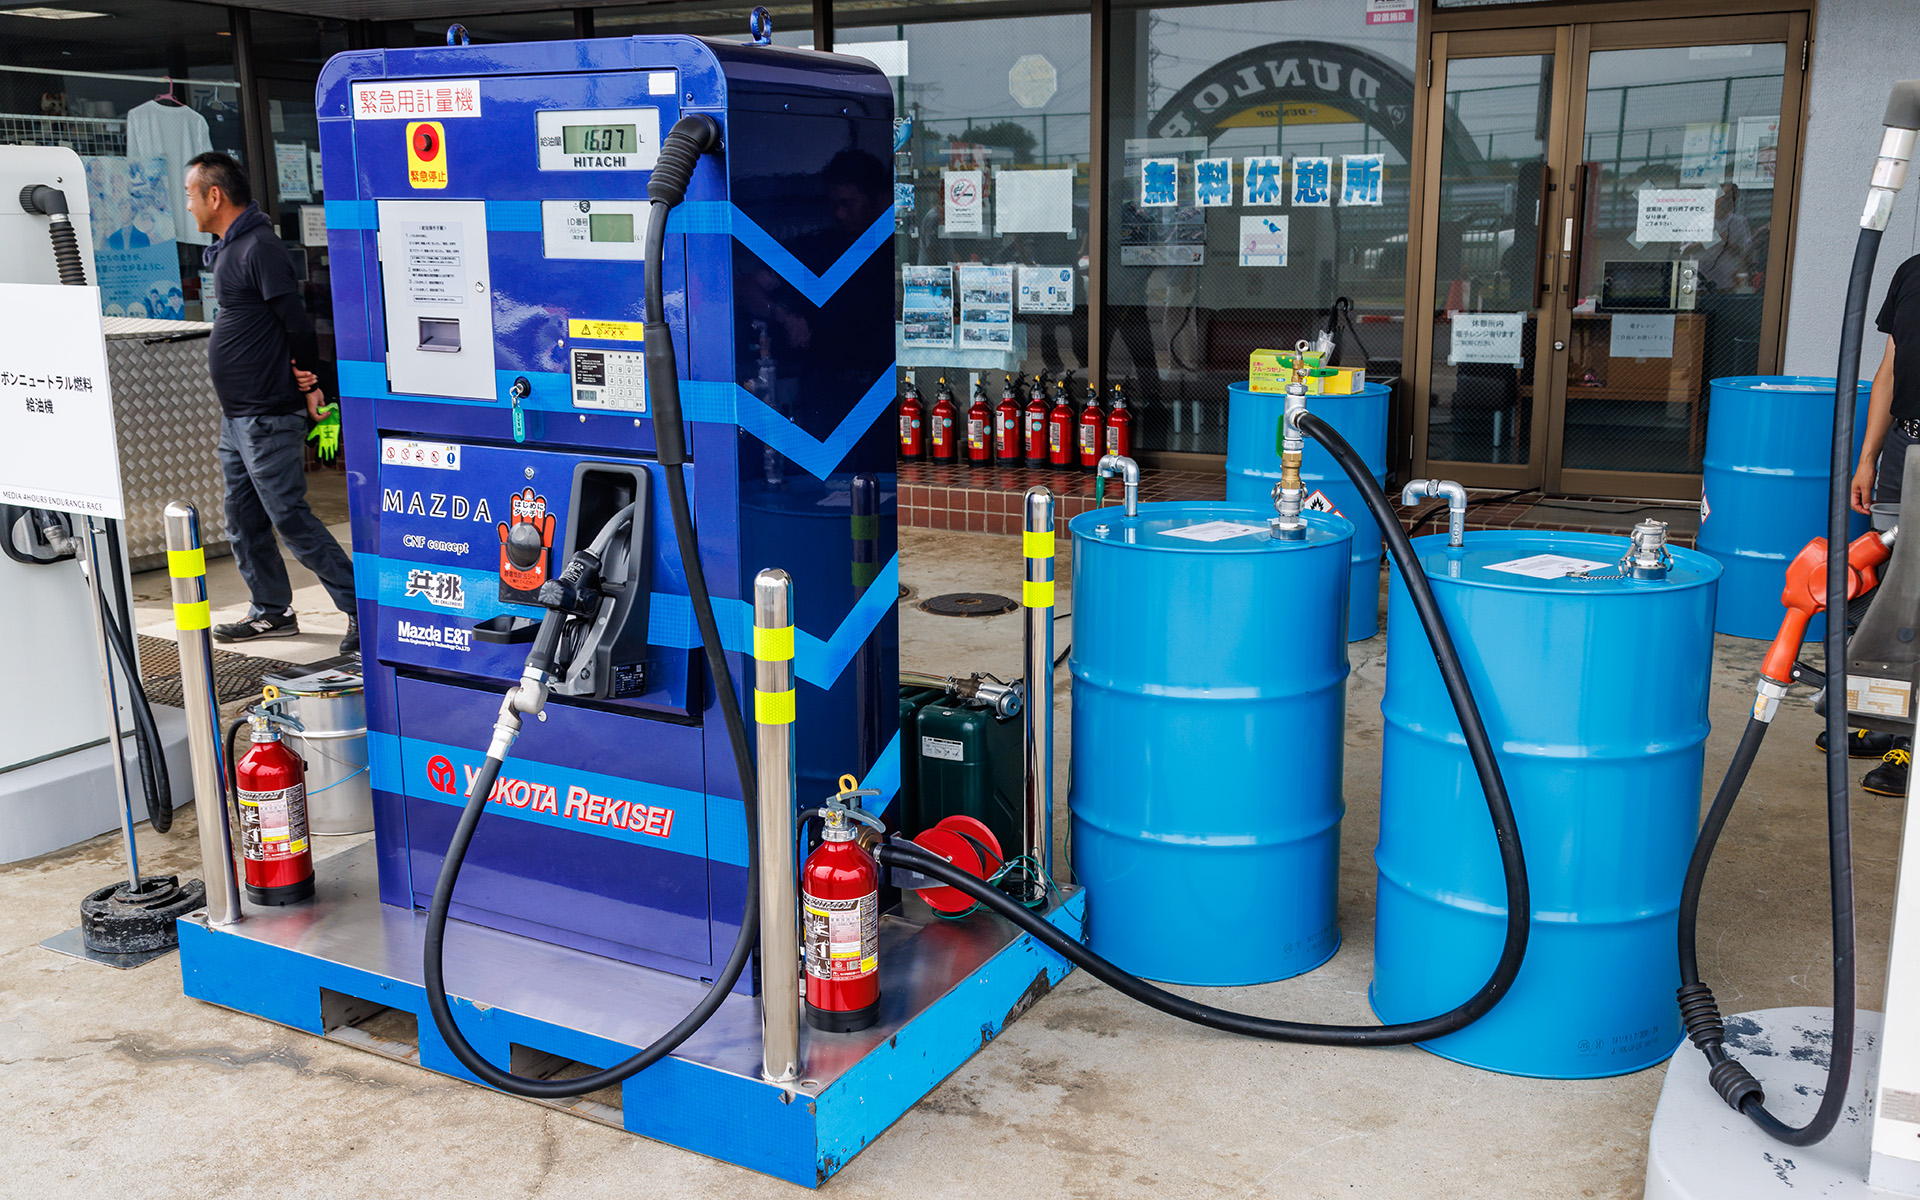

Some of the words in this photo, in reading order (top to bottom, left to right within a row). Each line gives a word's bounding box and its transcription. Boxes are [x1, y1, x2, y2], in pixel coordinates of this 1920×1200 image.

[359, 88, 474, 115] 緊急用計量機
[540, 136, 562, 147] 給油量
[573, 156, 627, 168] HITACHI
[410, 170, 447, 184] 緊急停止
[1143, 157, 1381, 205] 無料休憩所
[567, 217, 589, 227] ID番号
[1472, 320, 1505, 328] 休憩所内
[26, 397, 55, 415] 給油機
[3, 491, 22, 500] MEDIA
[49, 497, 85, 510] ENDURANCE
[87, 501, 103, 511] RACE
[382, 488, 493, 524] MAZDA
[514, 500, 545, 511] はじめに
[403, 534, 426, 549] CNF
[427, 539, 470, 556] concept
[398, 621, 442, 642] Mazda
[444, 627, 472, 646] E&T
[563, 785, 675, 838] REKISEI
